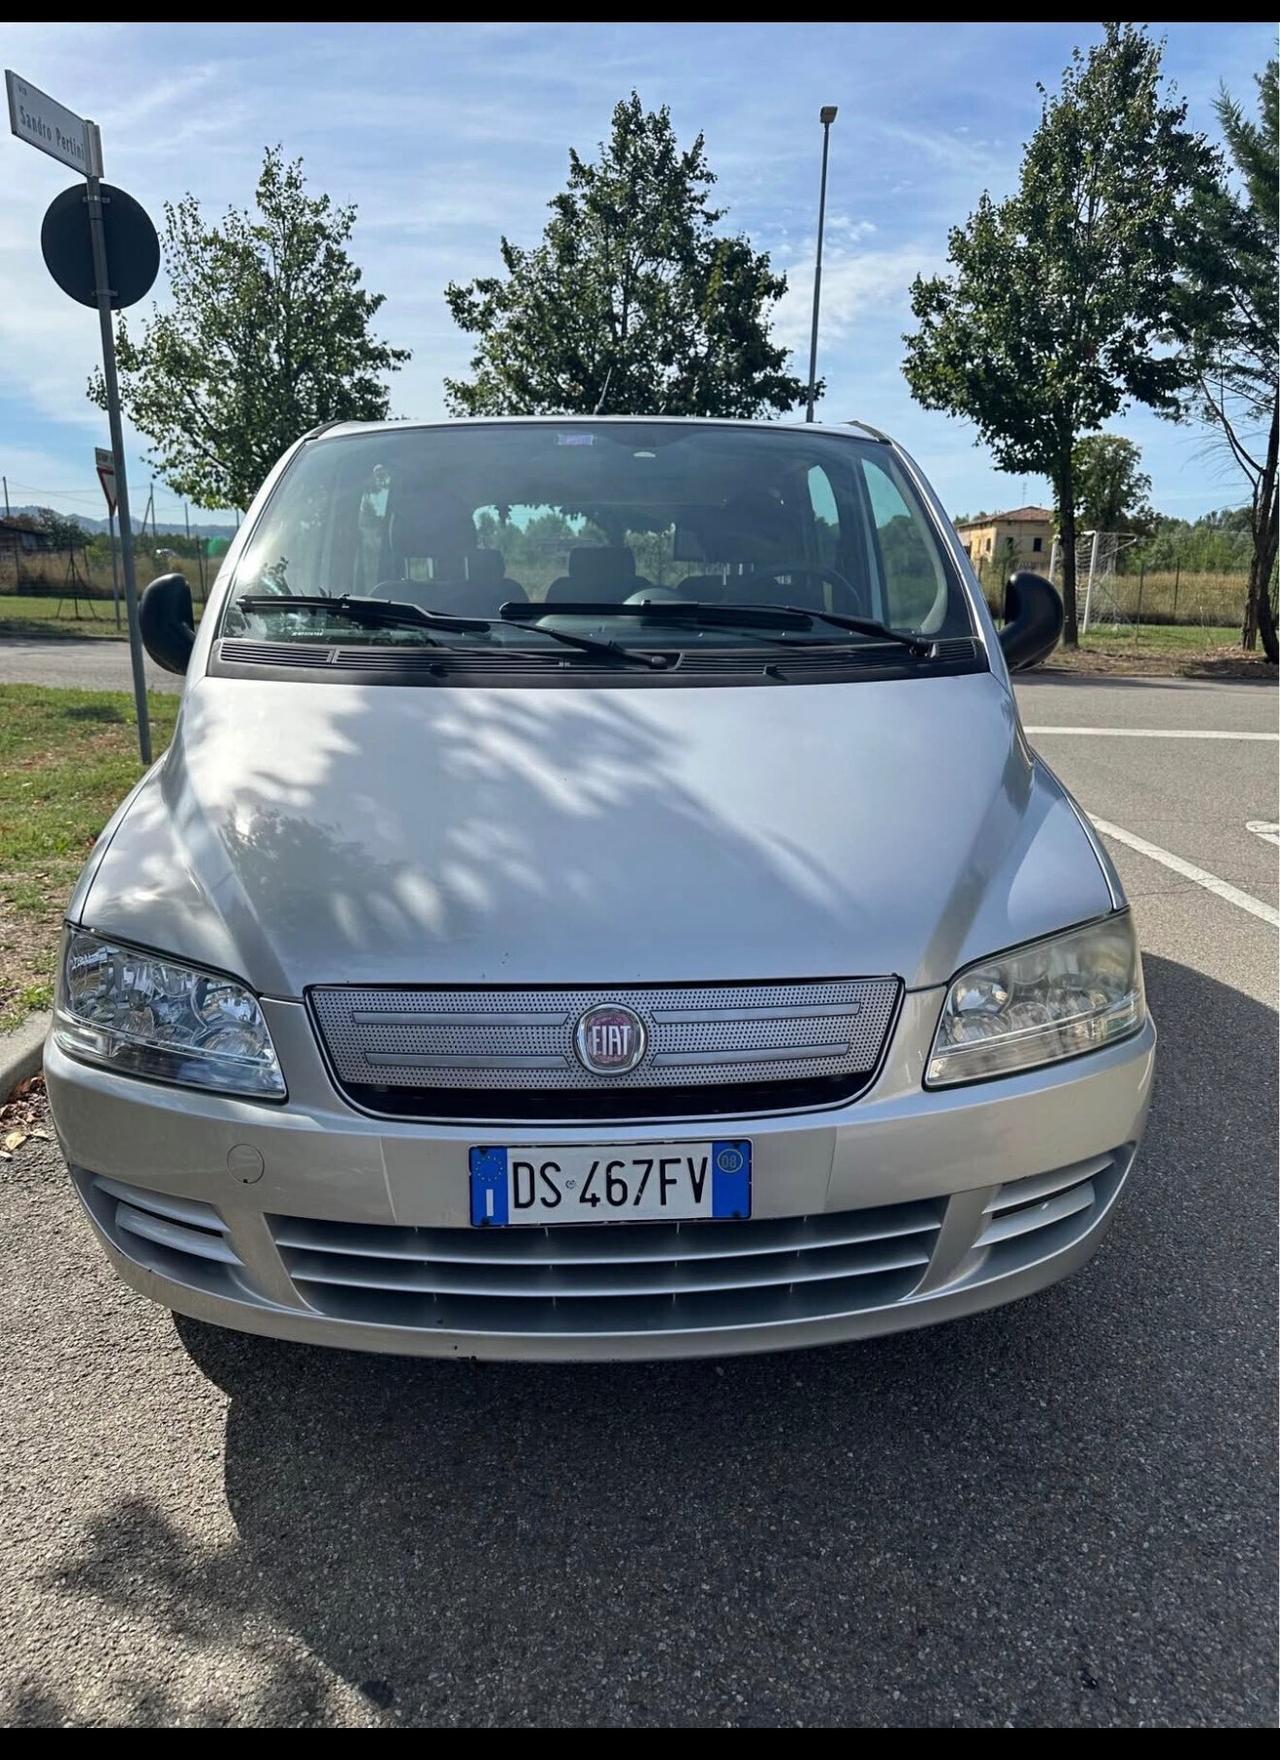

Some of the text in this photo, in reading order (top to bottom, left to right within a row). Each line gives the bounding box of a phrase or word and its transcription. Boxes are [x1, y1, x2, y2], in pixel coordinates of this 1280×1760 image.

[19, 105, 52, 141] Sandro
[592, 1025, 631, 1056] FIAT
[720, 1154, 737, 1169] 08
[512, 1156, 709, 1209] DS 467FV
[486, 1188, 494, 1216] I
